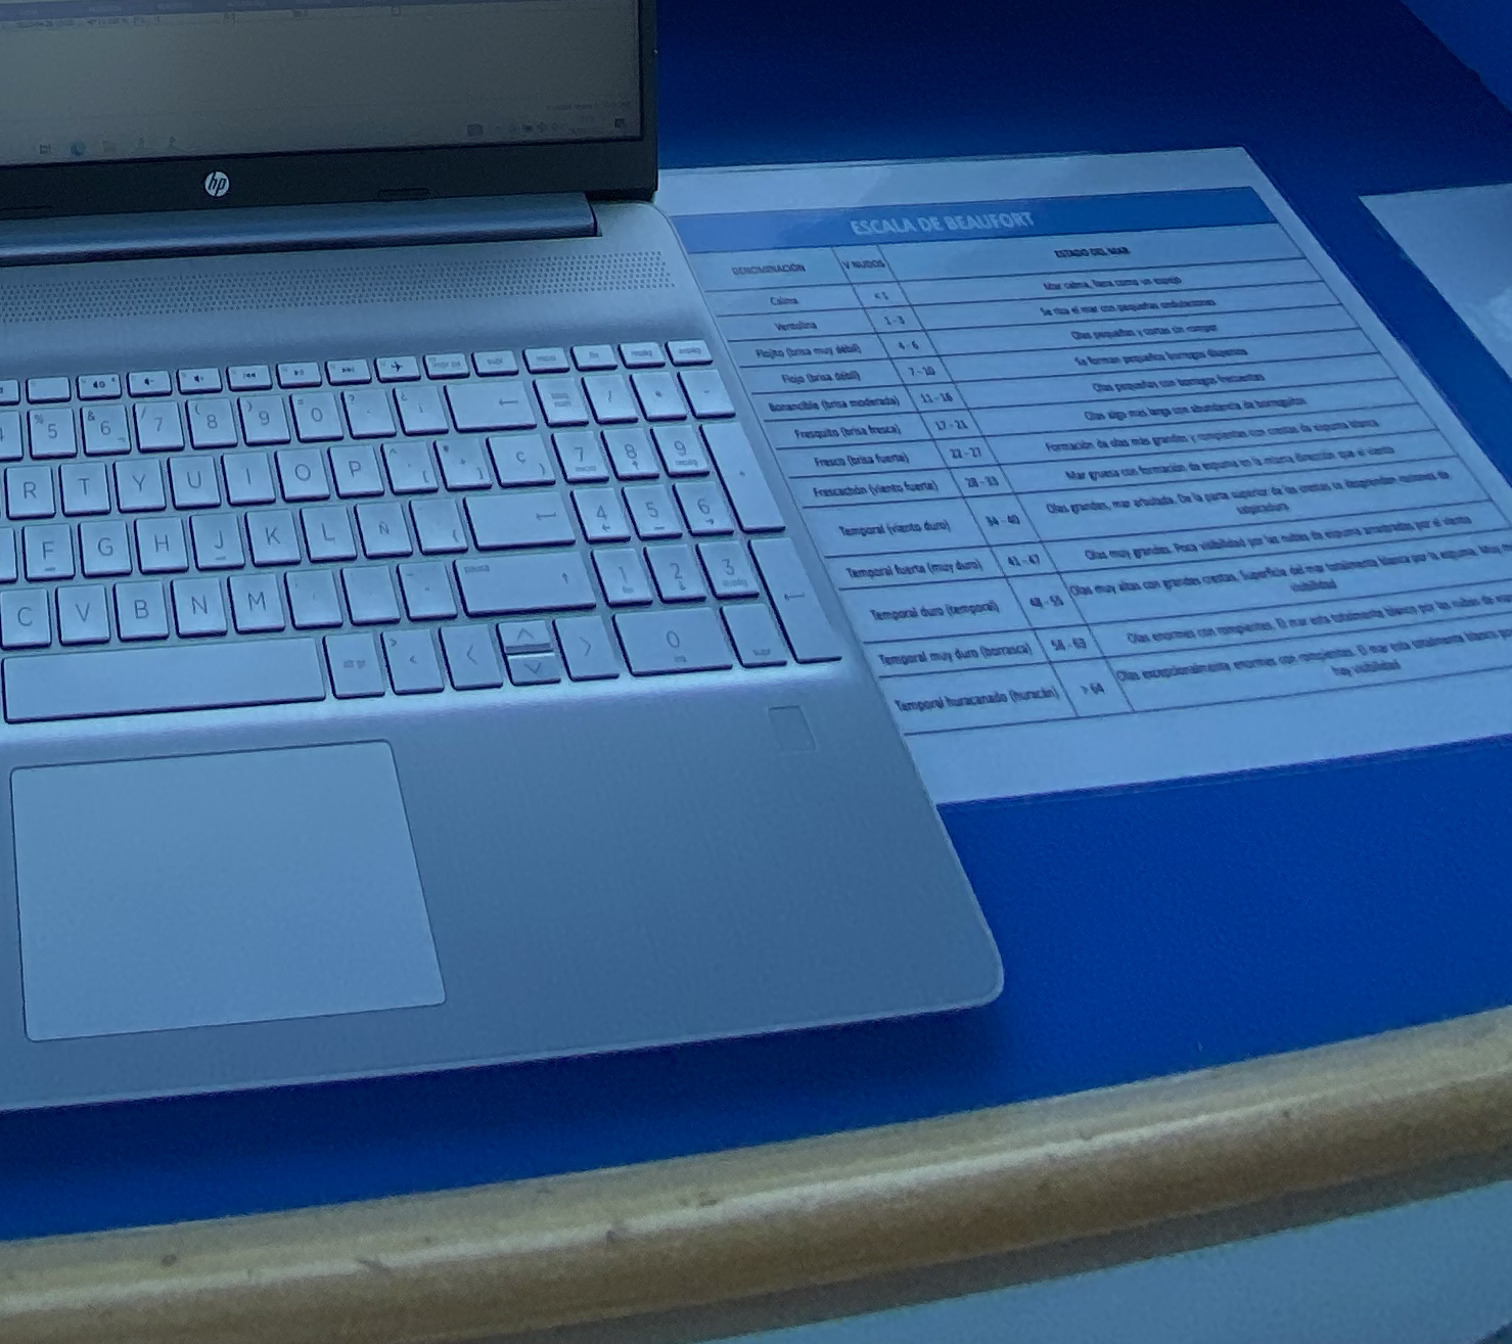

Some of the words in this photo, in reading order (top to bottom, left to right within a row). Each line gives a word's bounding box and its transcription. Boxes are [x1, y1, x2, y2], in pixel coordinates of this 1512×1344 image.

[204, 171, 230, 197] hp
[850, 218, 913, 236] ESCALA
[918, 216, 941, 233] DE
[943, 212, 1036, 232] BEAUFORT
[153, 416, 164, 433] 7
[206, 413, 219, 430] 8
[258, 410, 270, 426] 9
[47, 423, 58, 440] 5
[100, 419, 112, 436] 6
[574, 446, 585, 462] 7
[624, 443, 638, 460] 8
[673, 440, 687, 457] 9
[348, 460, 362, 477] P
[77, 477, 90, 496] T
[132, 474, 147, 492] Y
[188, 470, 202, 490] U
[23, 481, 38, 499] R
[595, 505, 607, 520] 4
[646, 501, 658, 519] 5
[697, 498, 710, 514] 6
[266, 526, 281, 545] K
[321, 523, 336, 542] L
[839, 524, 884, 538] Temporal
[97, 537, 114, 558] G
[154, 534, 169, 553] H
[214, 530, 224, 550] J
[41, 541, 55, 560] F
[670, 563, 683, 579] 2
[722, 559, 735, 576] 3
[846, 566, 893, 580] Temporal
[134, 600, 149, 619] B
[192, 596, 208, 614] N
[247, 591, 266, 611] M
[17, 606, 33, 627] C
[75, 603, 90, 623] V
[870, 608, 918, 622] Temporal
[879, 652, 927, 666] Temporal
[895, 698, 944, 713] Temporal
